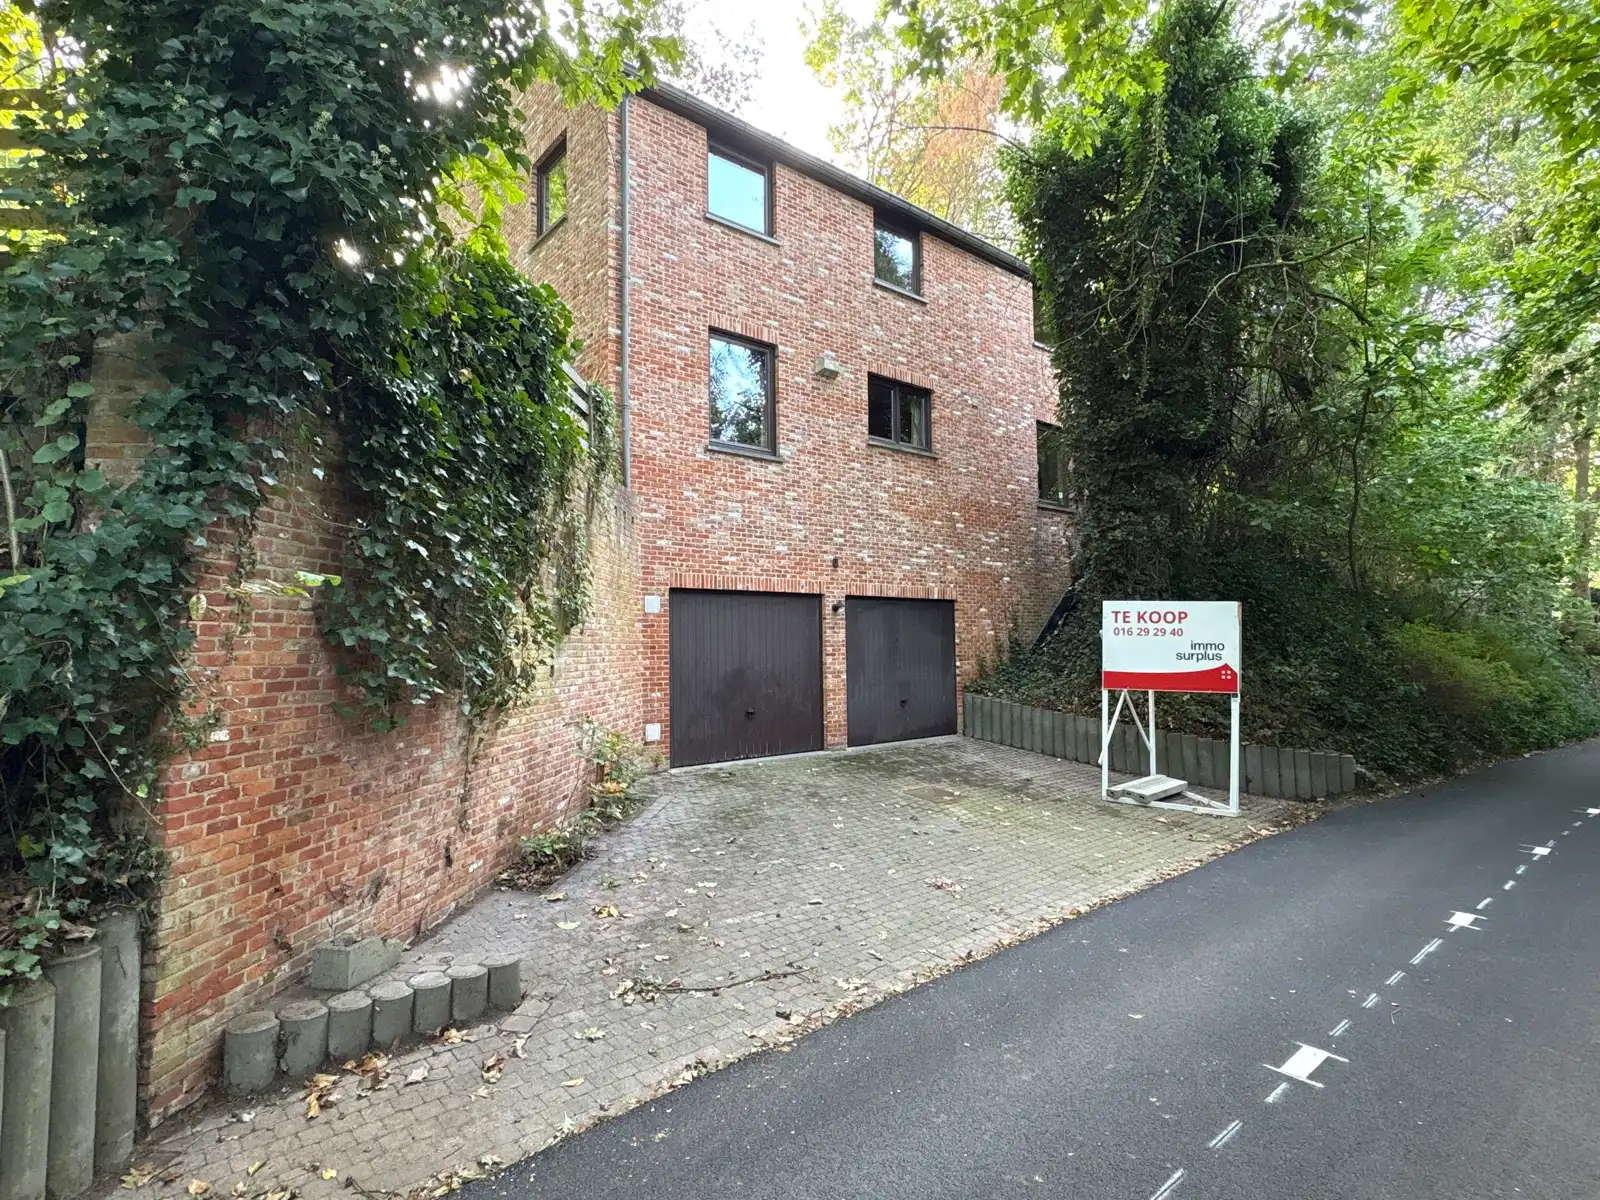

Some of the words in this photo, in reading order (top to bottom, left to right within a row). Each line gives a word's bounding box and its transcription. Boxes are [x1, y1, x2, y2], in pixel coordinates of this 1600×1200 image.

[1111, 610, 1131, 624] TE
[1137, 610, 1188, 624] KOOP
[1113, 627, 1133, 637] 016
[1136, 627, 1150, 637] 29
[1153, 627, 1166, 637] 29
[1169, 628, 1184, 637] 40
[1190, 640, 1225, 651] immo
[1175, 650, 1223, 663] surplus
